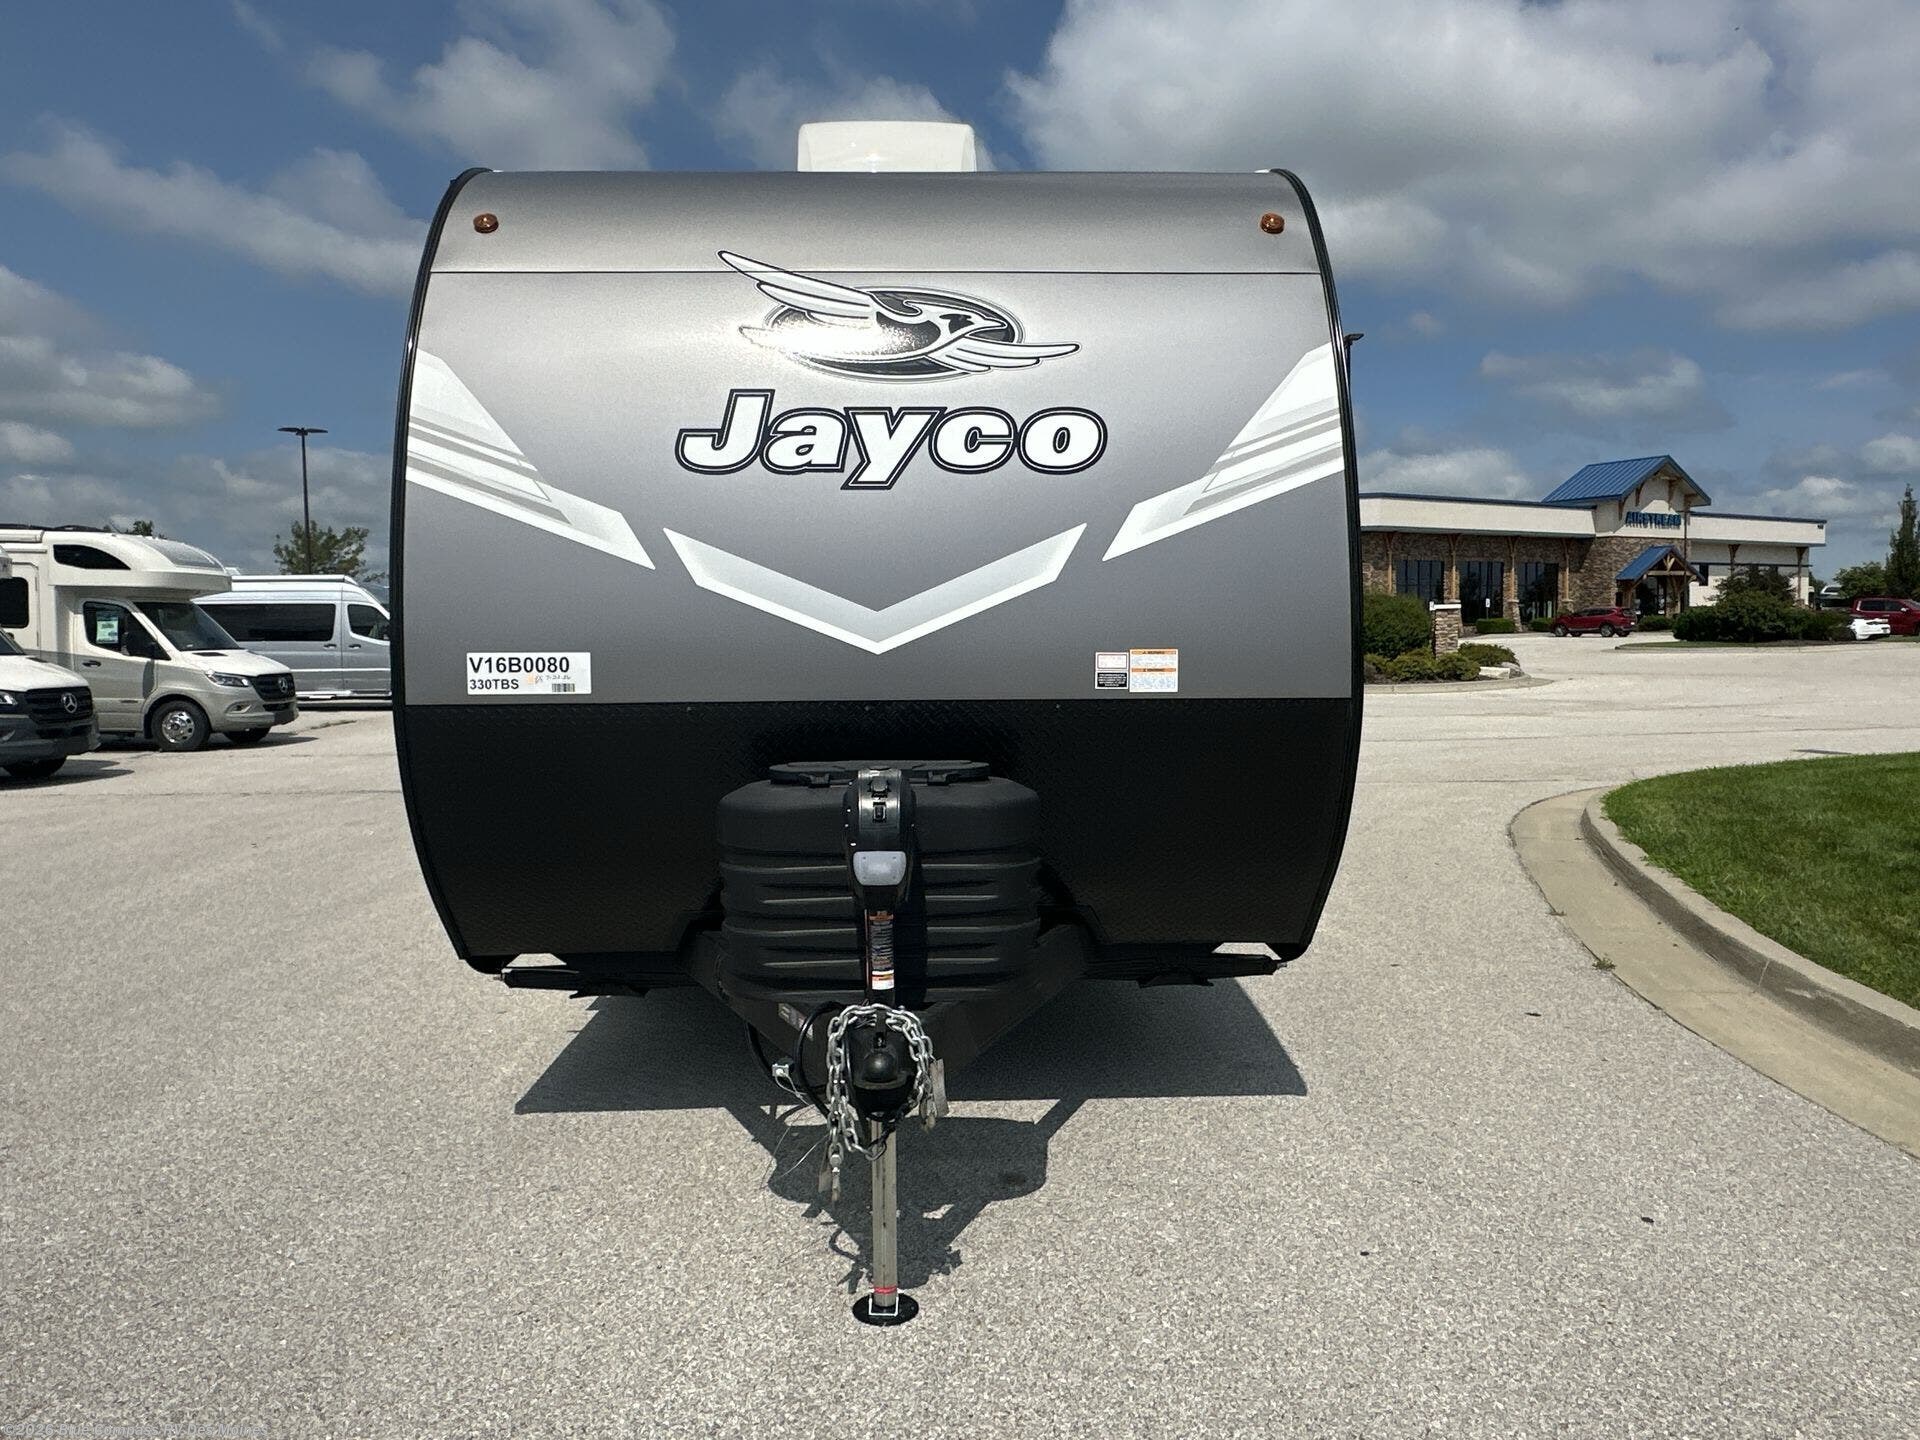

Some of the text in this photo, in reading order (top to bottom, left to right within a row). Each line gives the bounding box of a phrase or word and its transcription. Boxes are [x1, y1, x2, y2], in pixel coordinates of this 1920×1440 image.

[675, 388, 1109, 490] Jayco
[1625, 511, 1681, 526] AIRSTREAM
[469, 656, 570, 673] V16B0080
[469, 678, 519, 690] 330TBS
